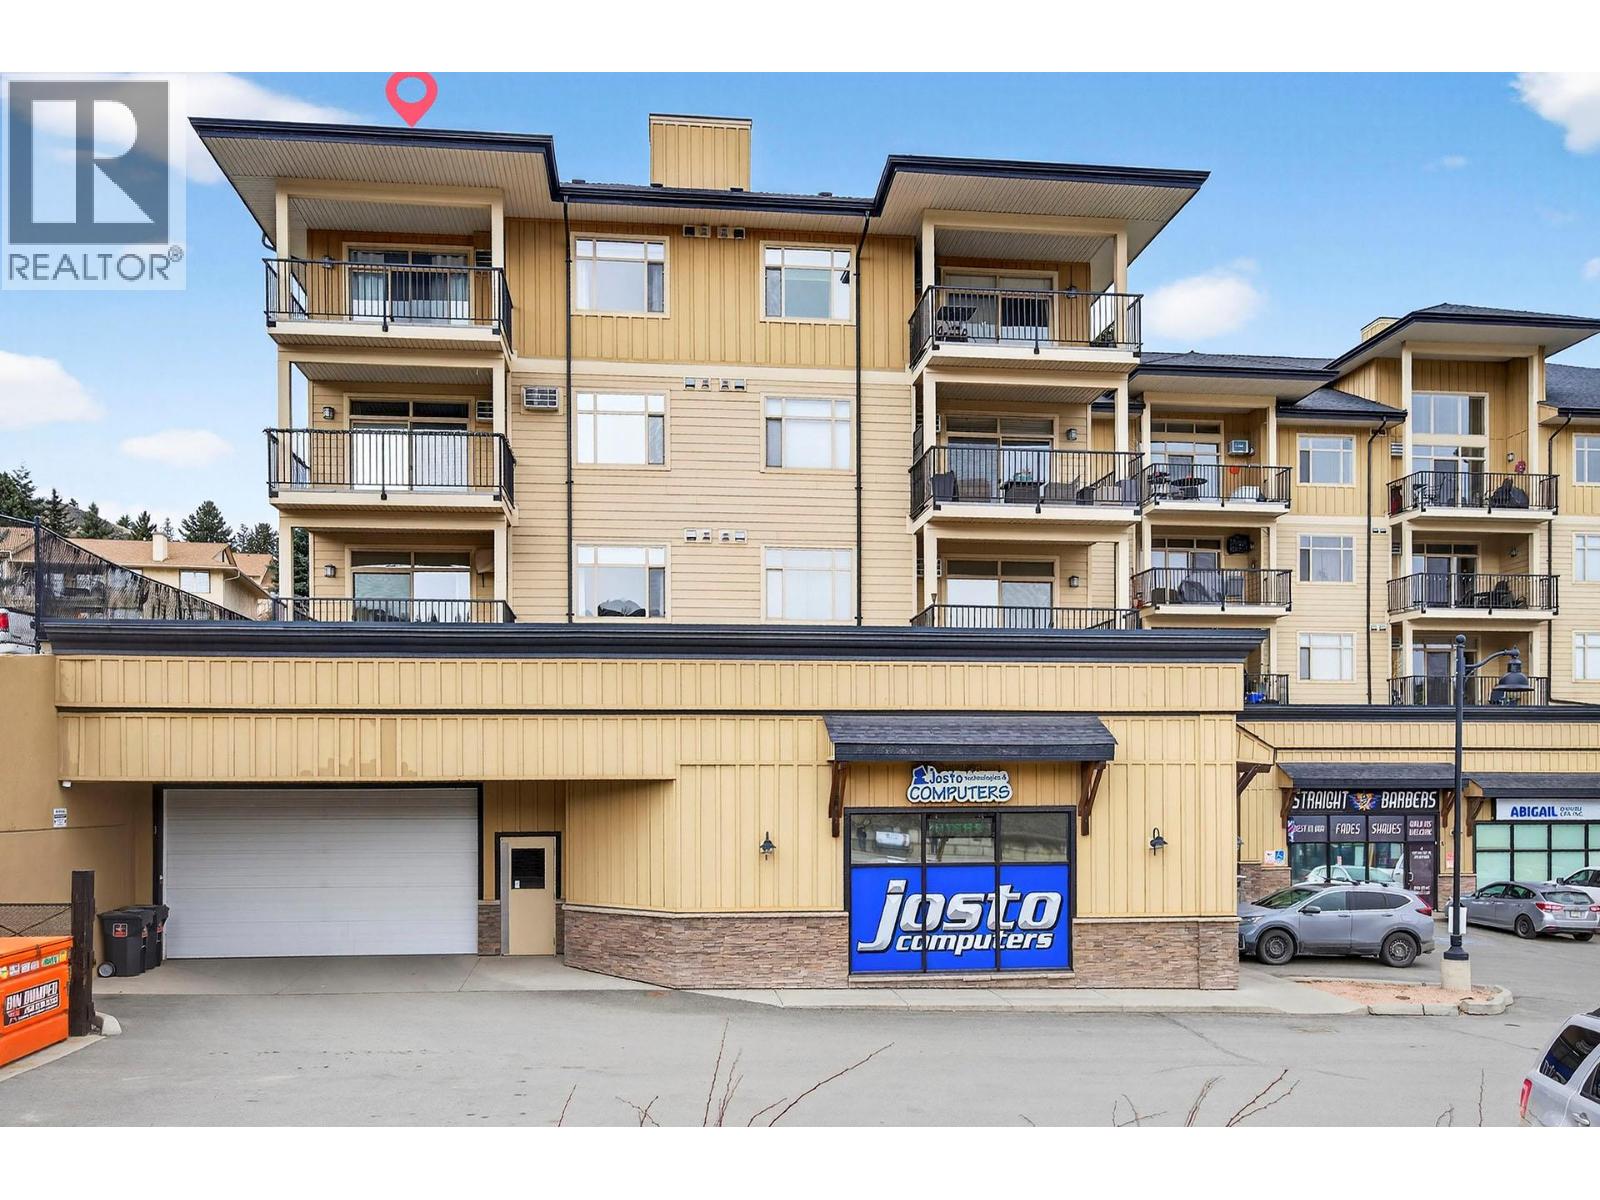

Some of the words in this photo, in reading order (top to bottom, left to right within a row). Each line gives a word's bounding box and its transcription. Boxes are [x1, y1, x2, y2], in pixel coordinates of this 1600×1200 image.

[930, 768, 963, 784] Josto
[909, 785, 1010, 801] COMPUTERS
[1292, 790, 1350, 810] STRAIGHT
[1380, 790, 1437, 809] BARBERS
[1510, 806, 1558, 818] ABIGAIL
[1335, 822, 1361, 835] FADES
[1371, 822, 1402, 835] SHAVES
[857, 879, 1062, 952] josto
[896, 932, 1053, 956] computers
